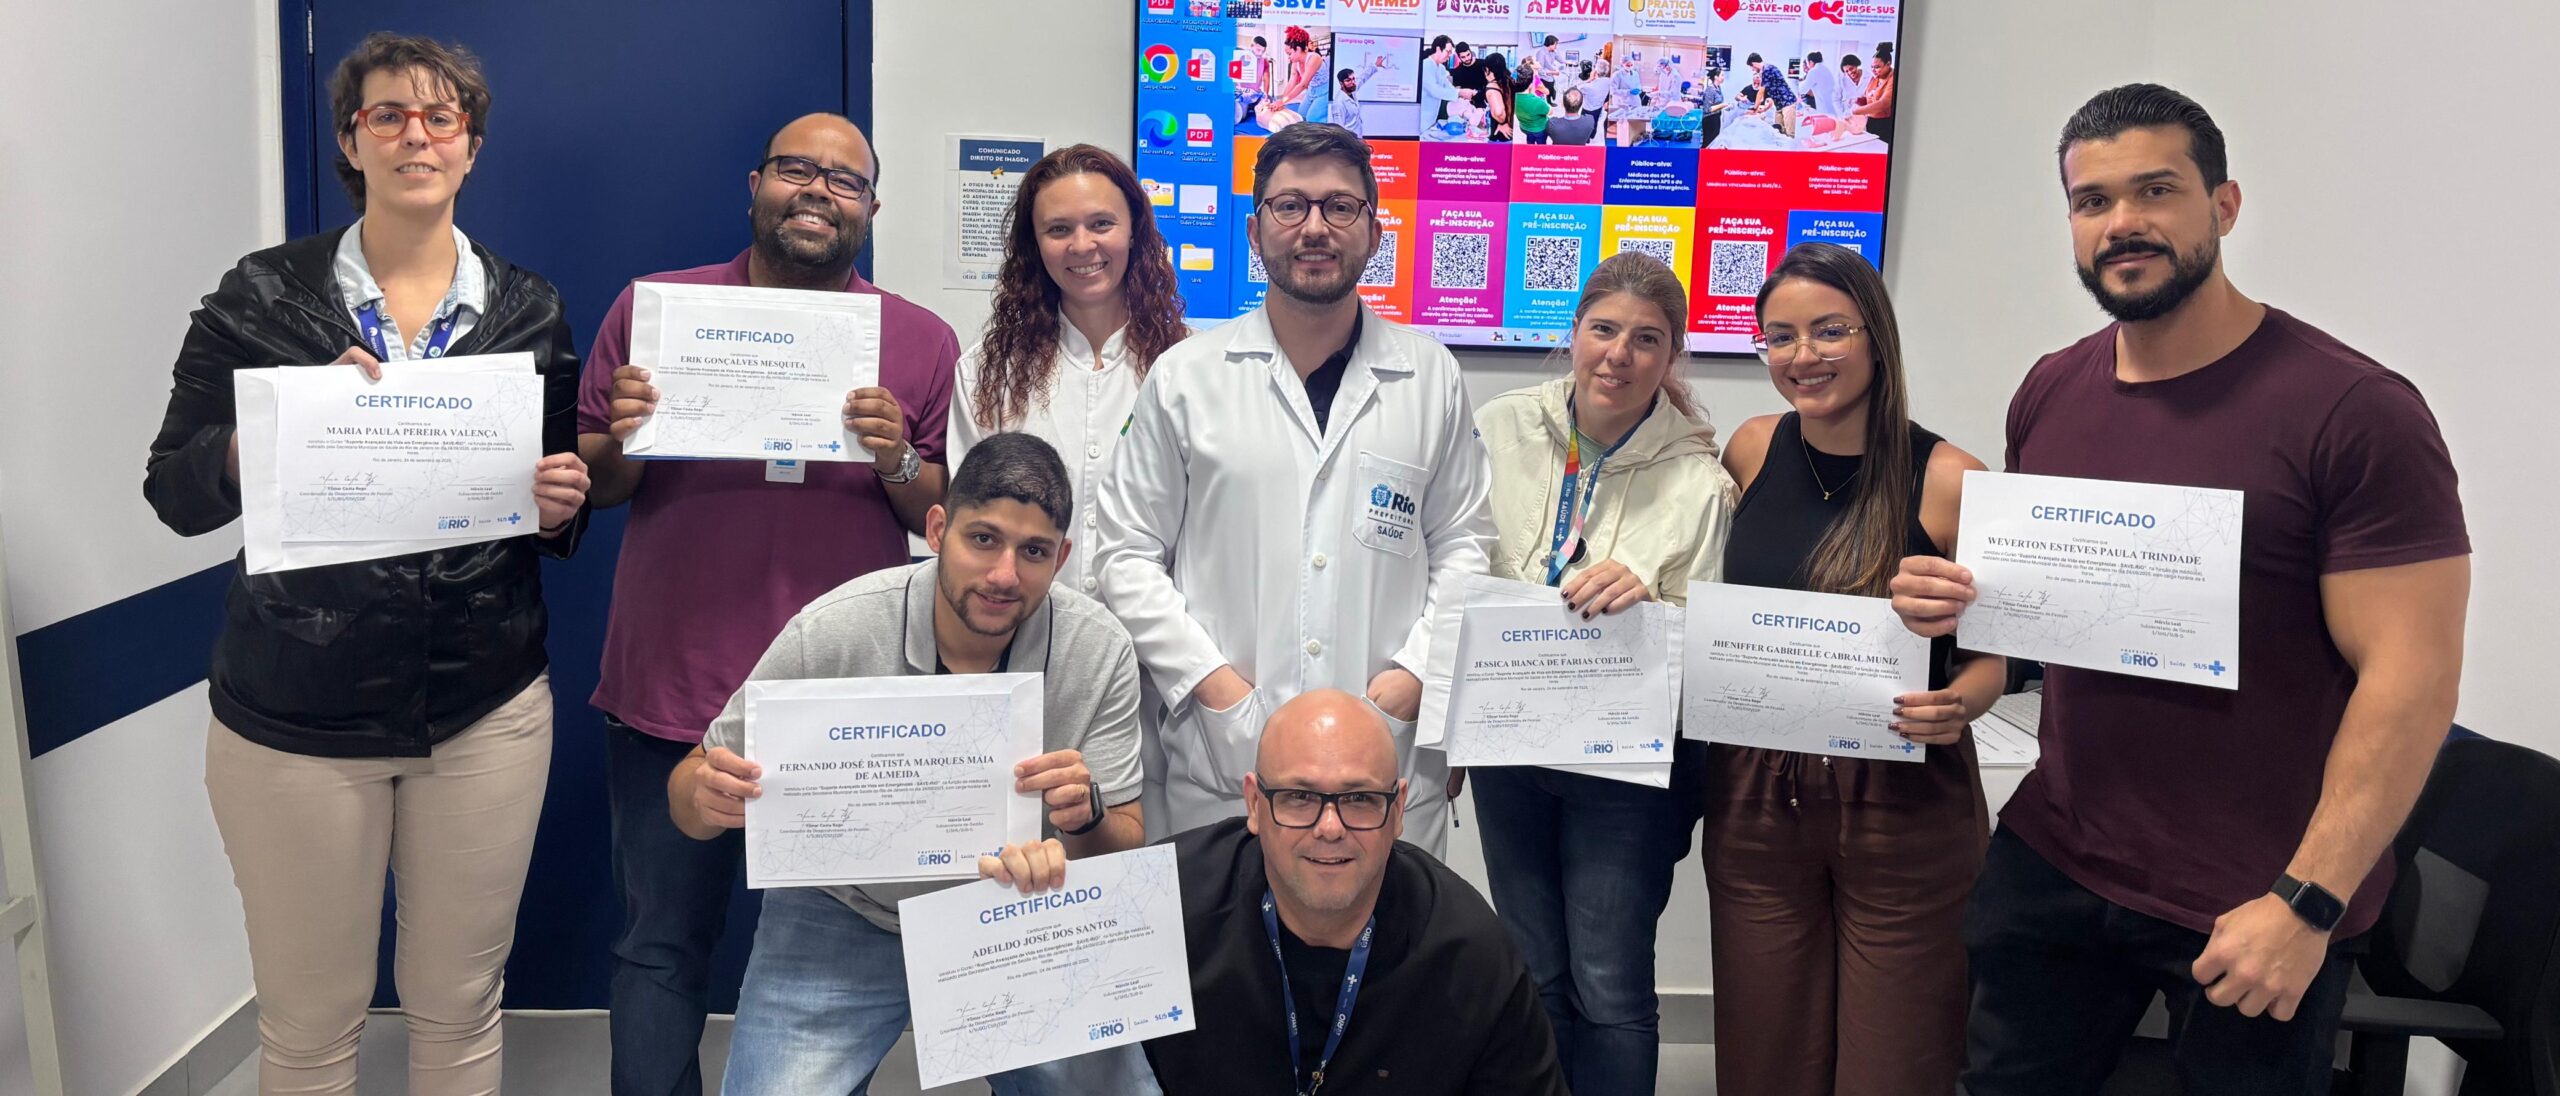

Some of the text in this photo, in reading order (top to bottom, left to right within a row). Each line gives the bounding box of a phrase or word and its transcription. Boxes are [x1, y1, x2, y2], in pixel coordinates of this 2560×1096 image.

[1463, 5, 1510, 14] VA-SUS
[1546, 0, 1610, 15] PBVM
[1748, 4, 1802, 13] SAVE-RIO
[1846, 6, 1895, 14] URGE-SUS
[1647, 9, 1697, 18] VA-SUS
[1190, 131, 1209, 139] PDF
[978, 147, 1021, 155] COMUNICADO
[1442, 210, 1464, 219] FAÇA
[1534, 213, 1556, 222] FAÇA
[1627, 215, 1650, 224] FAÇA
[1430, 219, 1494, 230] PRÉ-INSCRIÇÃO
[1523, 221, 1587, 232] PRÉ-INSCRIÇÃO
[1720, 218, 1762, 227] FAÇA SUA
[1814, 220, 1836, 229] FAÇA
[1615, 224, 1680, 234] PRÉ-INSCRIÇÃO
[1708, 227, 1774, 237] PRÉ-INSCRIÇÃO
[1802, 229, 1867, 239] PRÉ-INSCRIÇÃO
[1439, 296, 1478, 305] Atenção!
[1532, 299, 1569, 307] Atenção!
[1716, 304, 1755, 313] Atenção!
[695, 328, 794, 345] CERTIFICADO
[680, 355, 806, 370] ERIK GONÇALVES MESQUITA
[355, 394, 473, 410] CERTIFICADO
[326, 427, 498, 439] MARIA PAULA PEREIRA VALENÇA
[773, 442, 792, 451] RIO
[1392, 492, 1416, 516] Rio
[1369, 508, 1414, 526] PREFEITURA
[1559, 501, 1569, 523] SAÚDE
[2031, 505, 2156, 529] CERTIFICADO
[448, 519, 470, 530] RIO
[1377, 526, 1404, 540] SAÚDE
[1988, 537, 2202, 565] WEVERTON ESTEVES PAULA TRINDADE
[1752, 612, 1861, 635] CERTIFICADO
[1502, 628, 1602, 642] CERTIFICADO
[1712, 639, 1900, 666] JHENIFFER GABRIELLE CABRAL MUNIZ
[1474, 656, 1633, 669] JÉSSICA BIANCA DE FARIAS COELHO
[2134, 654, 2158, 668] RIO
[2193, 662, 2208, 670] SUS
[829, 723, 946, 741] CERTIFICADO
[1594, 744, 1613, 754] RIO
[1839, 740, 1860, 750] RIO
[780, 755, 994, 772] FERNANDO JOSÉ BATISTA MARQUES MAIA
[855, 770, 920, 781] DE ALMEIDA
[929, 853, 951, 865] RIO
[979, 886, 1102, 925] CERTIFICADO
[972, 919, 1118, 959] ADEILDO JOSÉ DOS SANTOS
[1362, 927, 1372, 943] RIO
[1337, 1013, 1346, 1030] RIO
[1101, 1022, 1125, 1039] RIO
